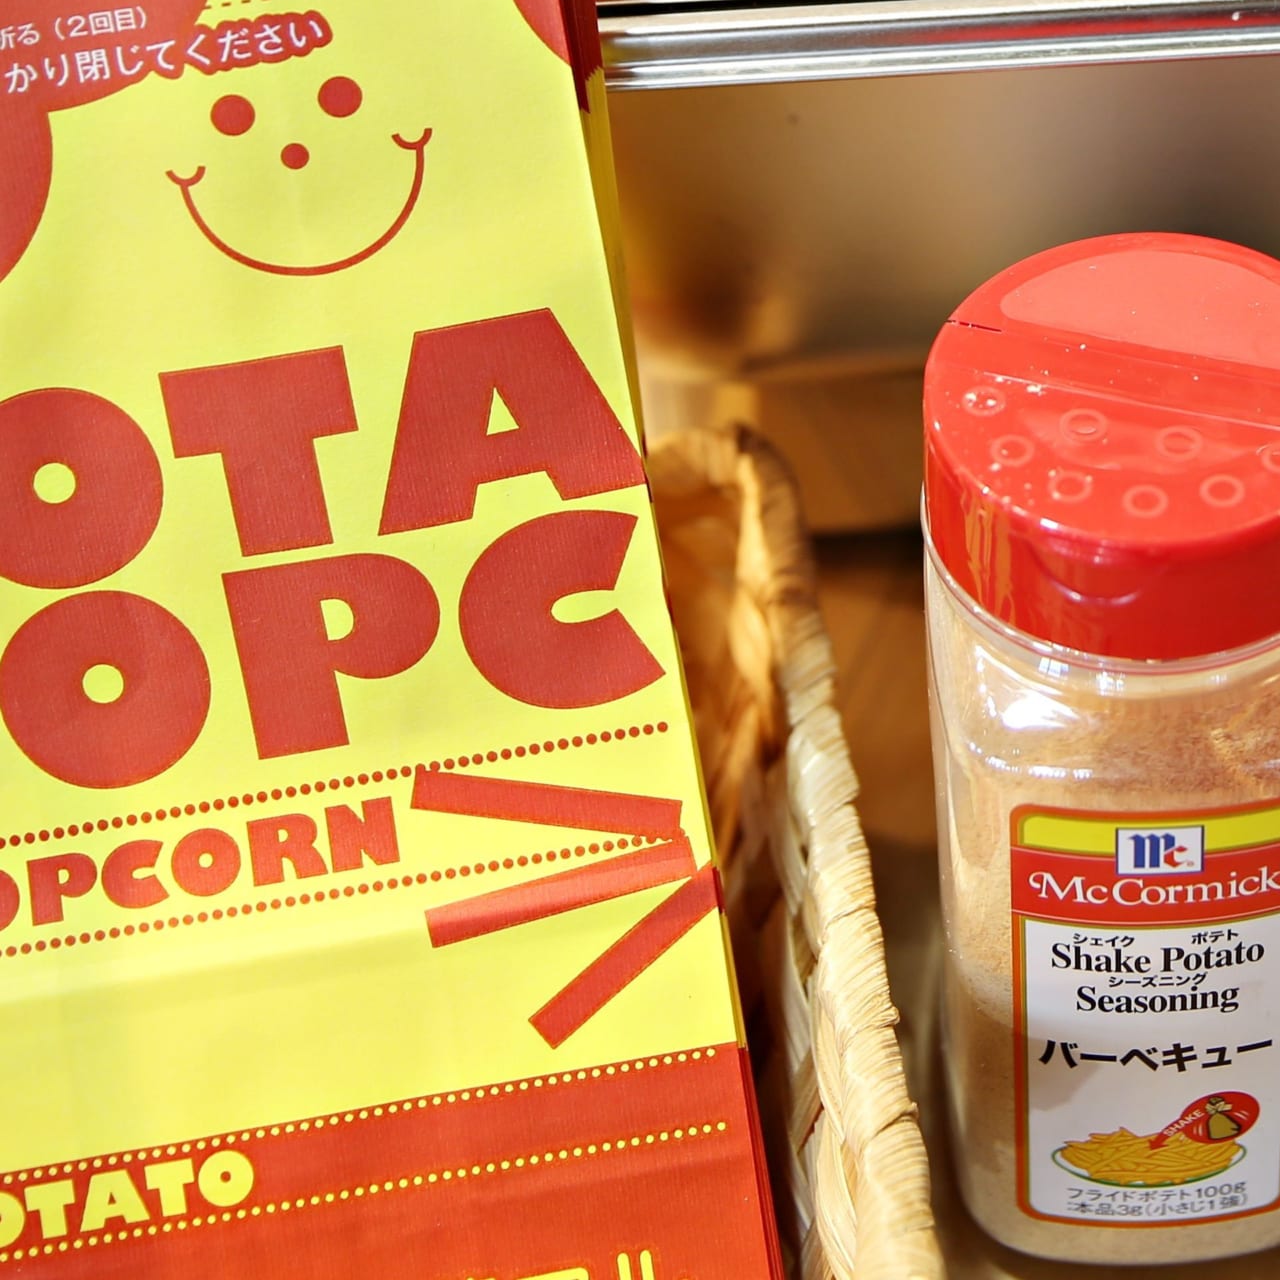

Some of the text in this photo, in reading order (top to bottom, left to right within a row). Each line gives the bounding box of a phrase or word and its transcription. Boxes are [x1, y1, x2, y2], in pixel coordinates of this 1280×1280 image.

[5, 20, 323, 94] かり閉じてください
[0, 307, 646, 589] OTA
[0, 509, 666, 789] OPC
[0, 796, 400, 932] PCORN
[1072, 929, 1240, 948] シェイク ポテト
[1051, 941, 1265, 974] Shake Potato
[1108, 972, 1208, 988] シーズニング
[1076, 985, 1240, 1014] Seasoning
[1039, 1039, 1273, 1072] バーベキュー
[1163, 1108, 1206, 1138] SHAKE
